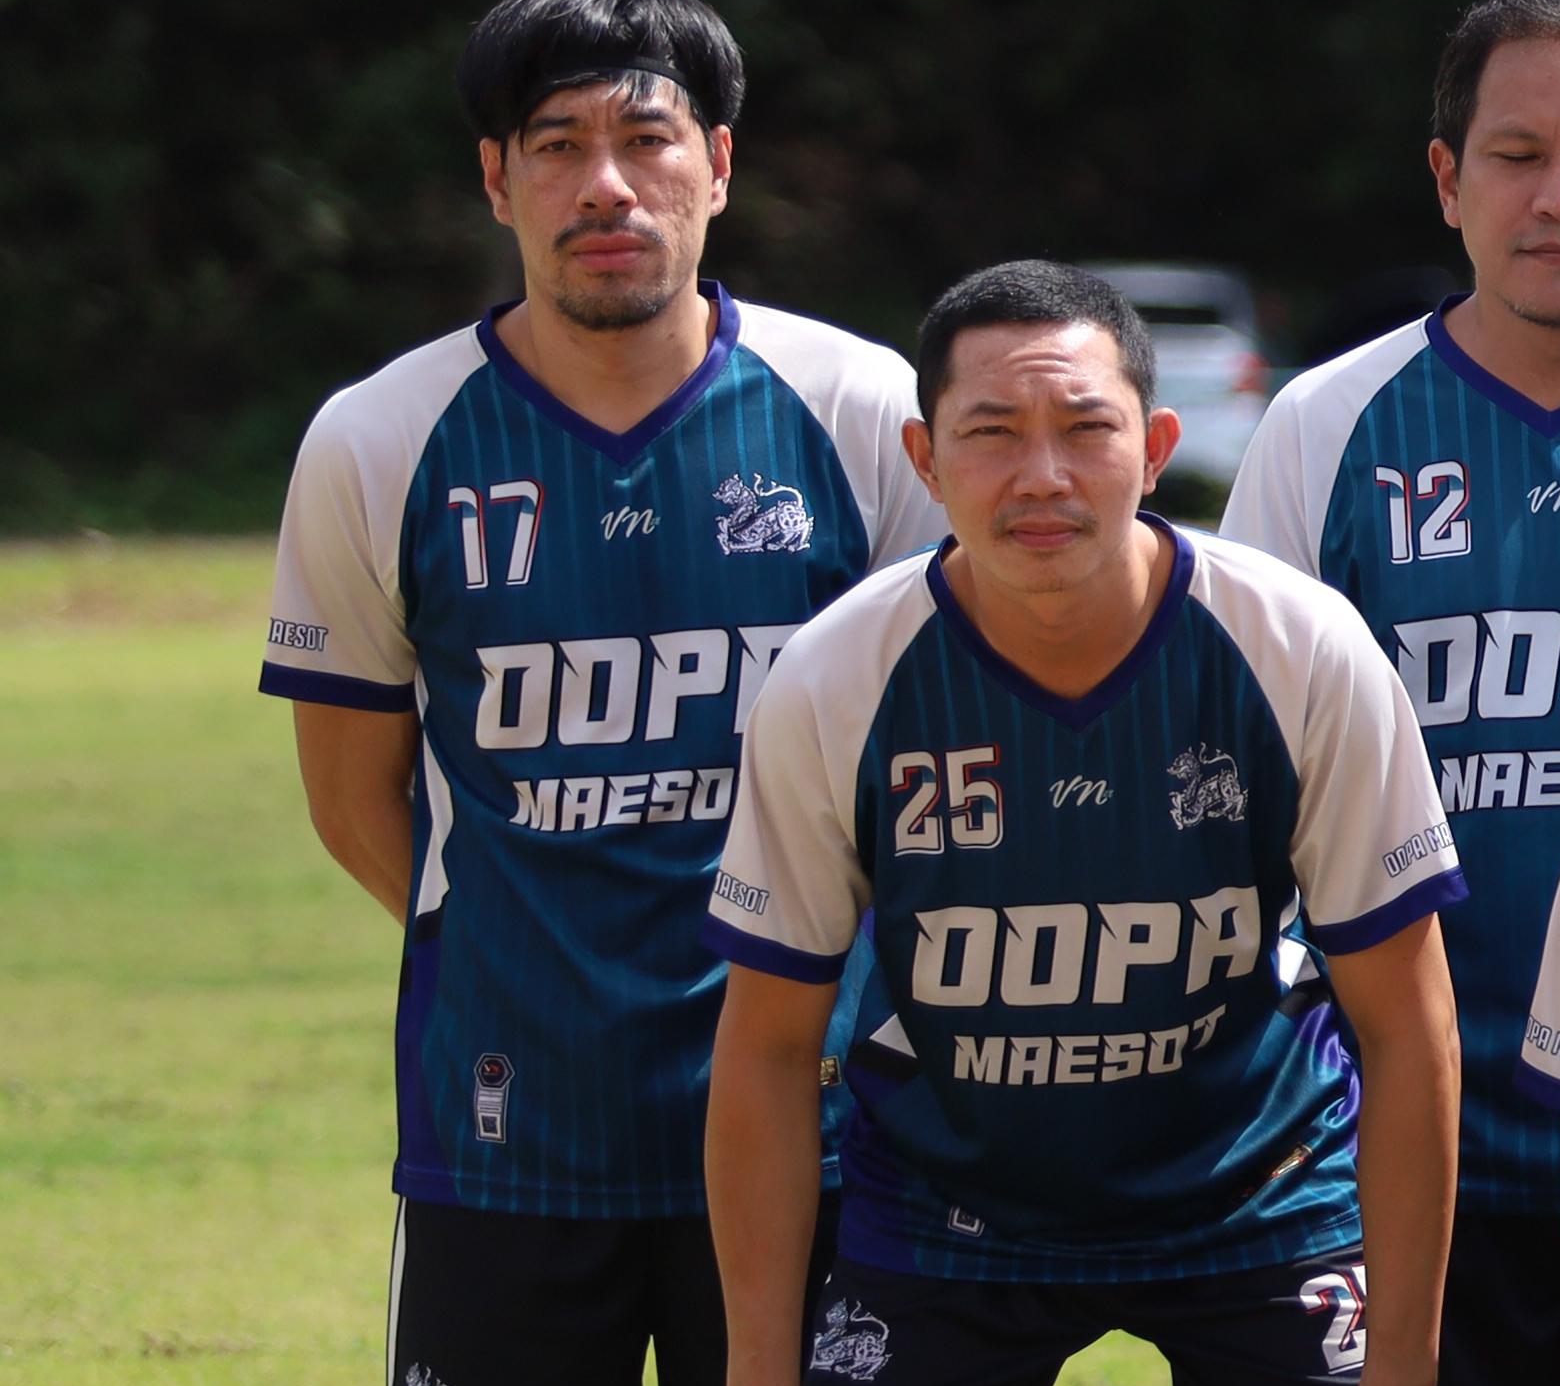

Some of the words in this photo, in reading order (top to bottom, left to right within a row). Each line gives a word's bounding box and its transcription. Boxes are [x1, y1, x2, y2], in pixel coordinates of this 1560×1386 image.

[447, 477, 545, 590] 17
[1375, 460, 1472, 564] 12
[267, 616, 329, 652] AESOT
[508, 767, 735, 832] MAESO
[890, 744, 1003, 857] 25
[911, 886, 1262, 1007] DOPA
[953, 1005, 1227, 1086] MAESOT
